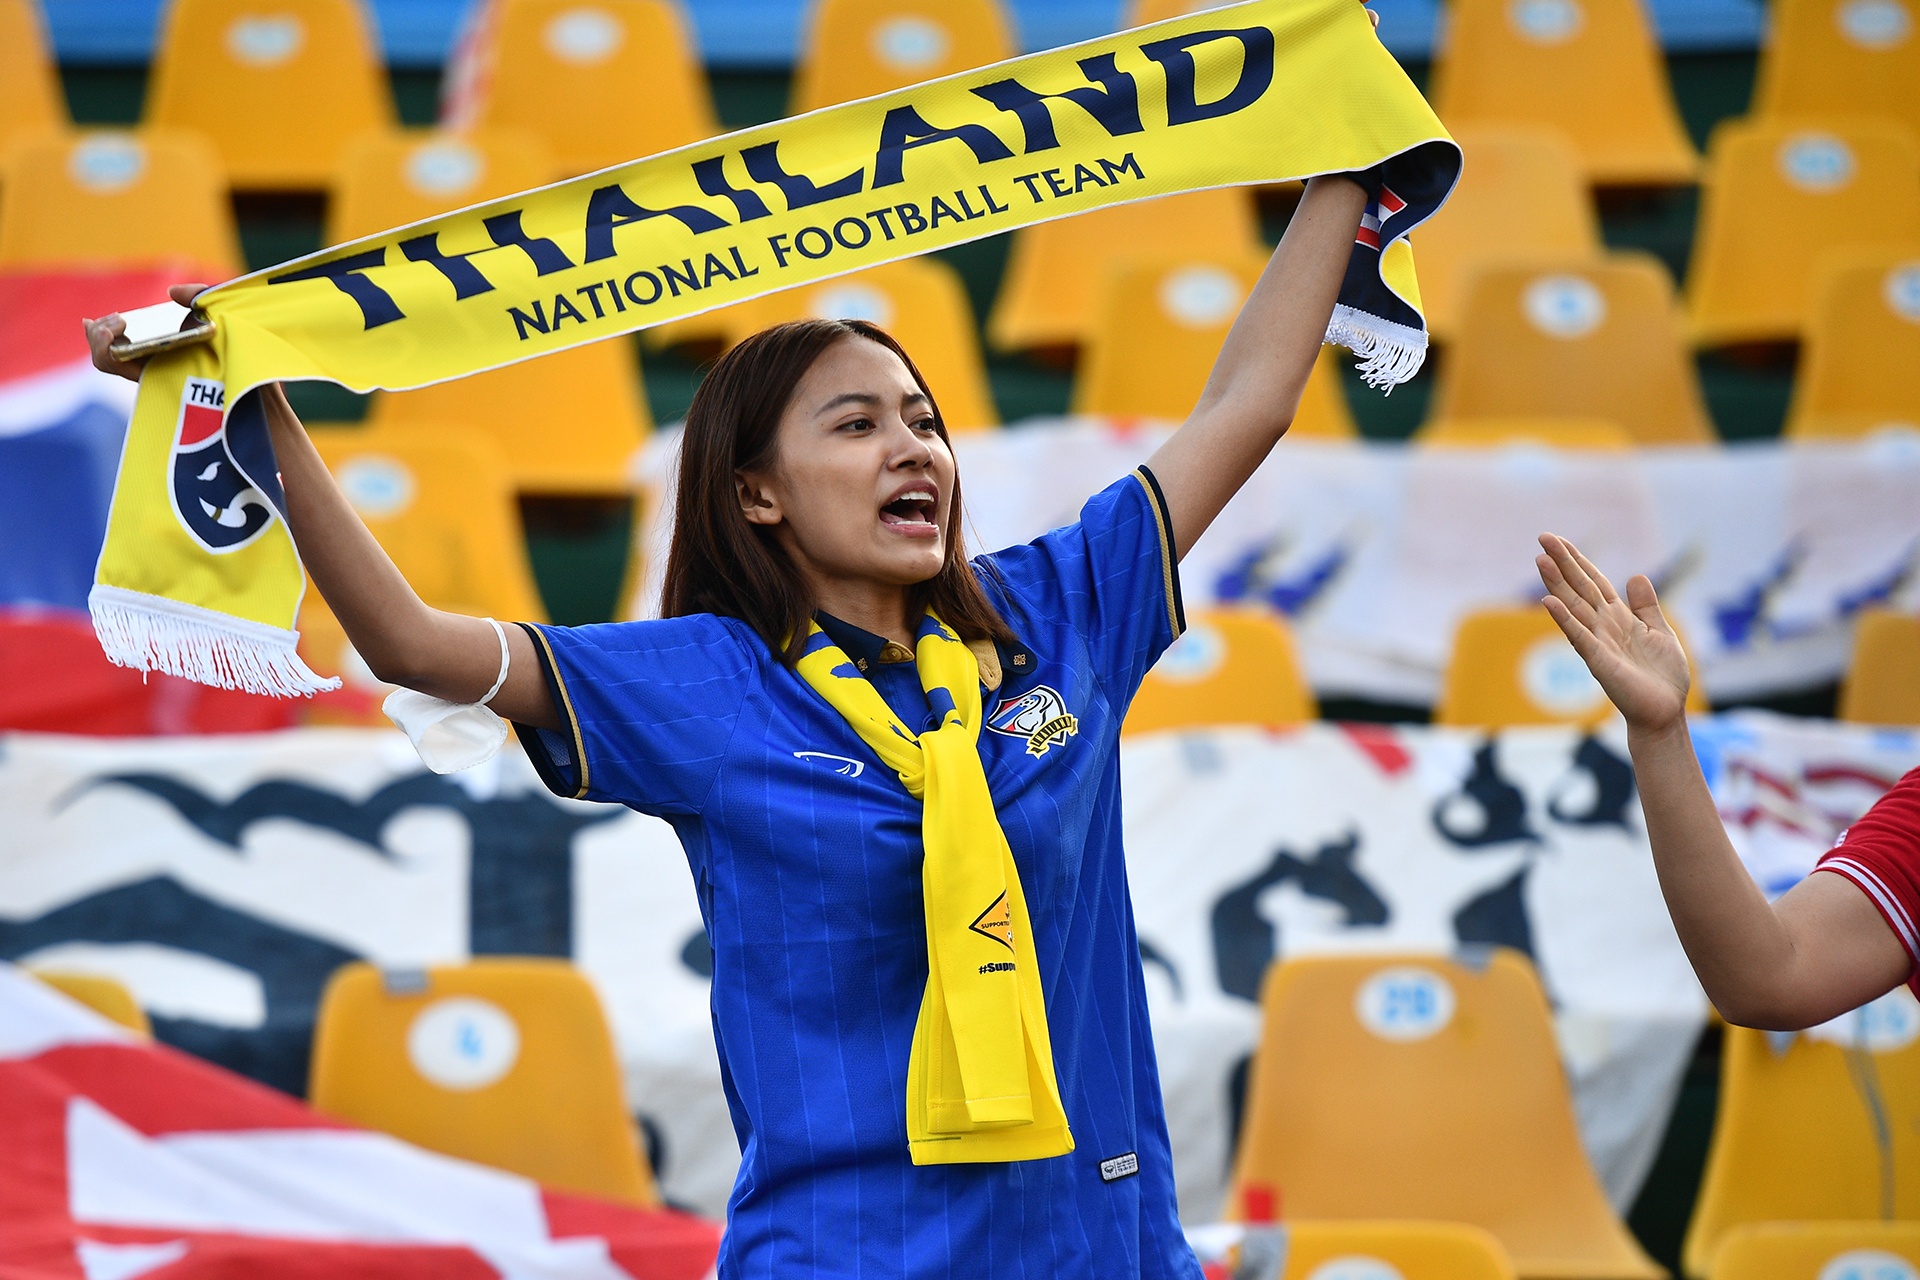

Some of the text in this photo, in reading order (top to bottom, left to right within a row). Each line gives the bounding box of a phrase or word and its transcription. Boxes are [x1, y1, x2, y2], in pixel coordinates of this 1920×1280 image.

[267, 26, 1275, 331] THAILAND
[506, 153, 1146, 341] NATIONAL FOOTBALL TEAM
